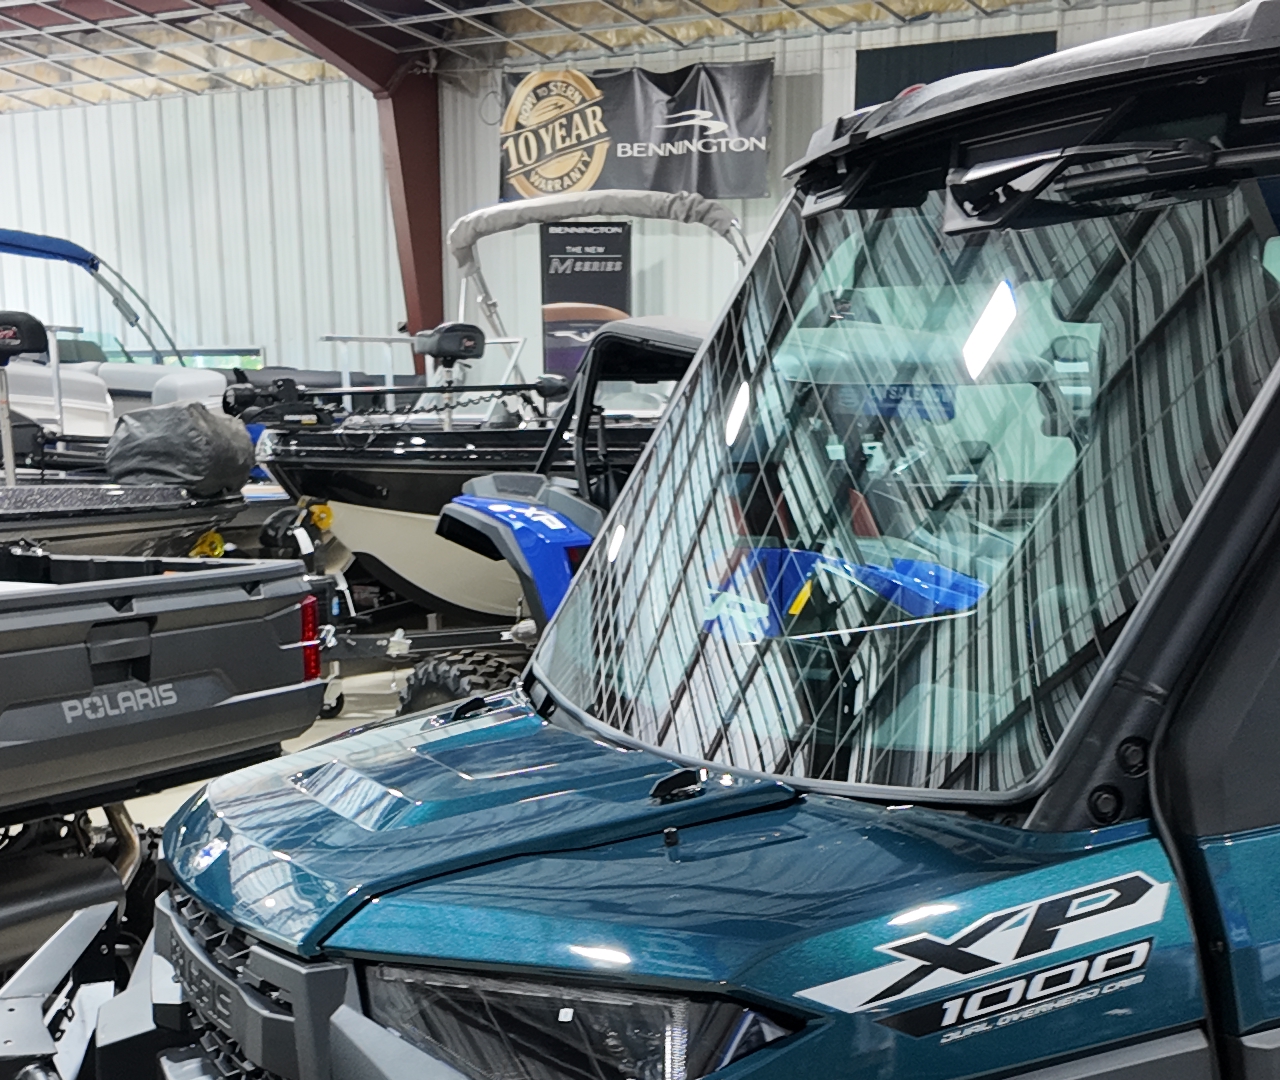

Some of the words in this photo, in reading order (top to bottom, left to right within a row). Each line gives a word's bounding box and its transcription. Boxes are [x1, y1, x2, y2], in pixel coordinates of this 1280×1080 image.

[536, 87, 548, 97] TO
[549, 82, 582, 104] STERN
[502, 131, 538, 171] 10
[538, 105, 608, 155] YEAR
[616, 136, 766, 157] BENNINGTON
[529, 151, 591, 191] WARRANTY
[548, 226, 622, 234] BENNINGTON
[61, 683, 178, 724] POLARIS
[858, 874, 1153, 1007] XP
[940, 940, 1150, 1026] 1000
[940, 1022, 993, 1044] DUAL
[996, 987, 1100, 1027] OVERHEAD
[1101, 974, 1145, 995] CAM
